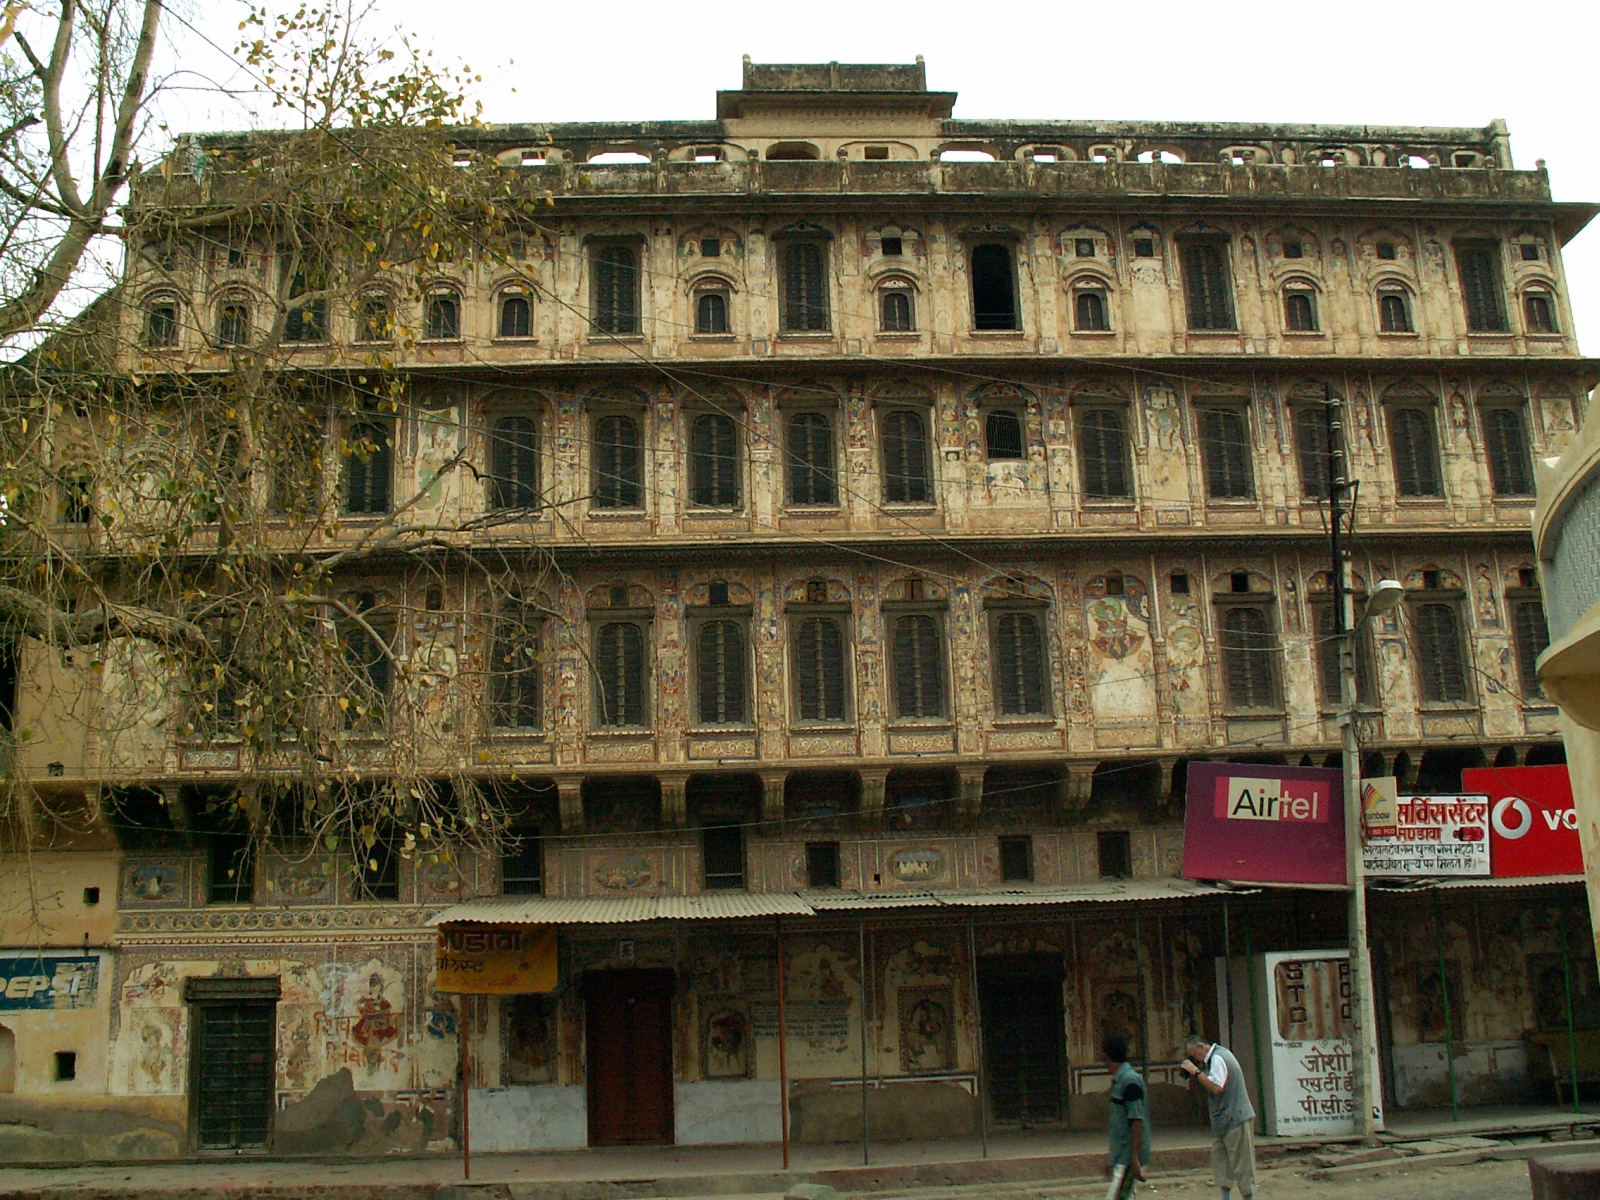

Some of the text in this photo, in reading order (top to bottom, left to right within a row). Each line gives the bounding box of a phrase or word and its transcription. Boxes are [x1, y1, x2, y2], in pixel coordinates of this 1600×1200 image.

[1232, 788, 1318, 820] Airtel
[1449, 797, 1487, 825] सेंटर
[1286, 961, 1308, 1024] STD
[1300, 1044, 1351, 1073] जोशी
